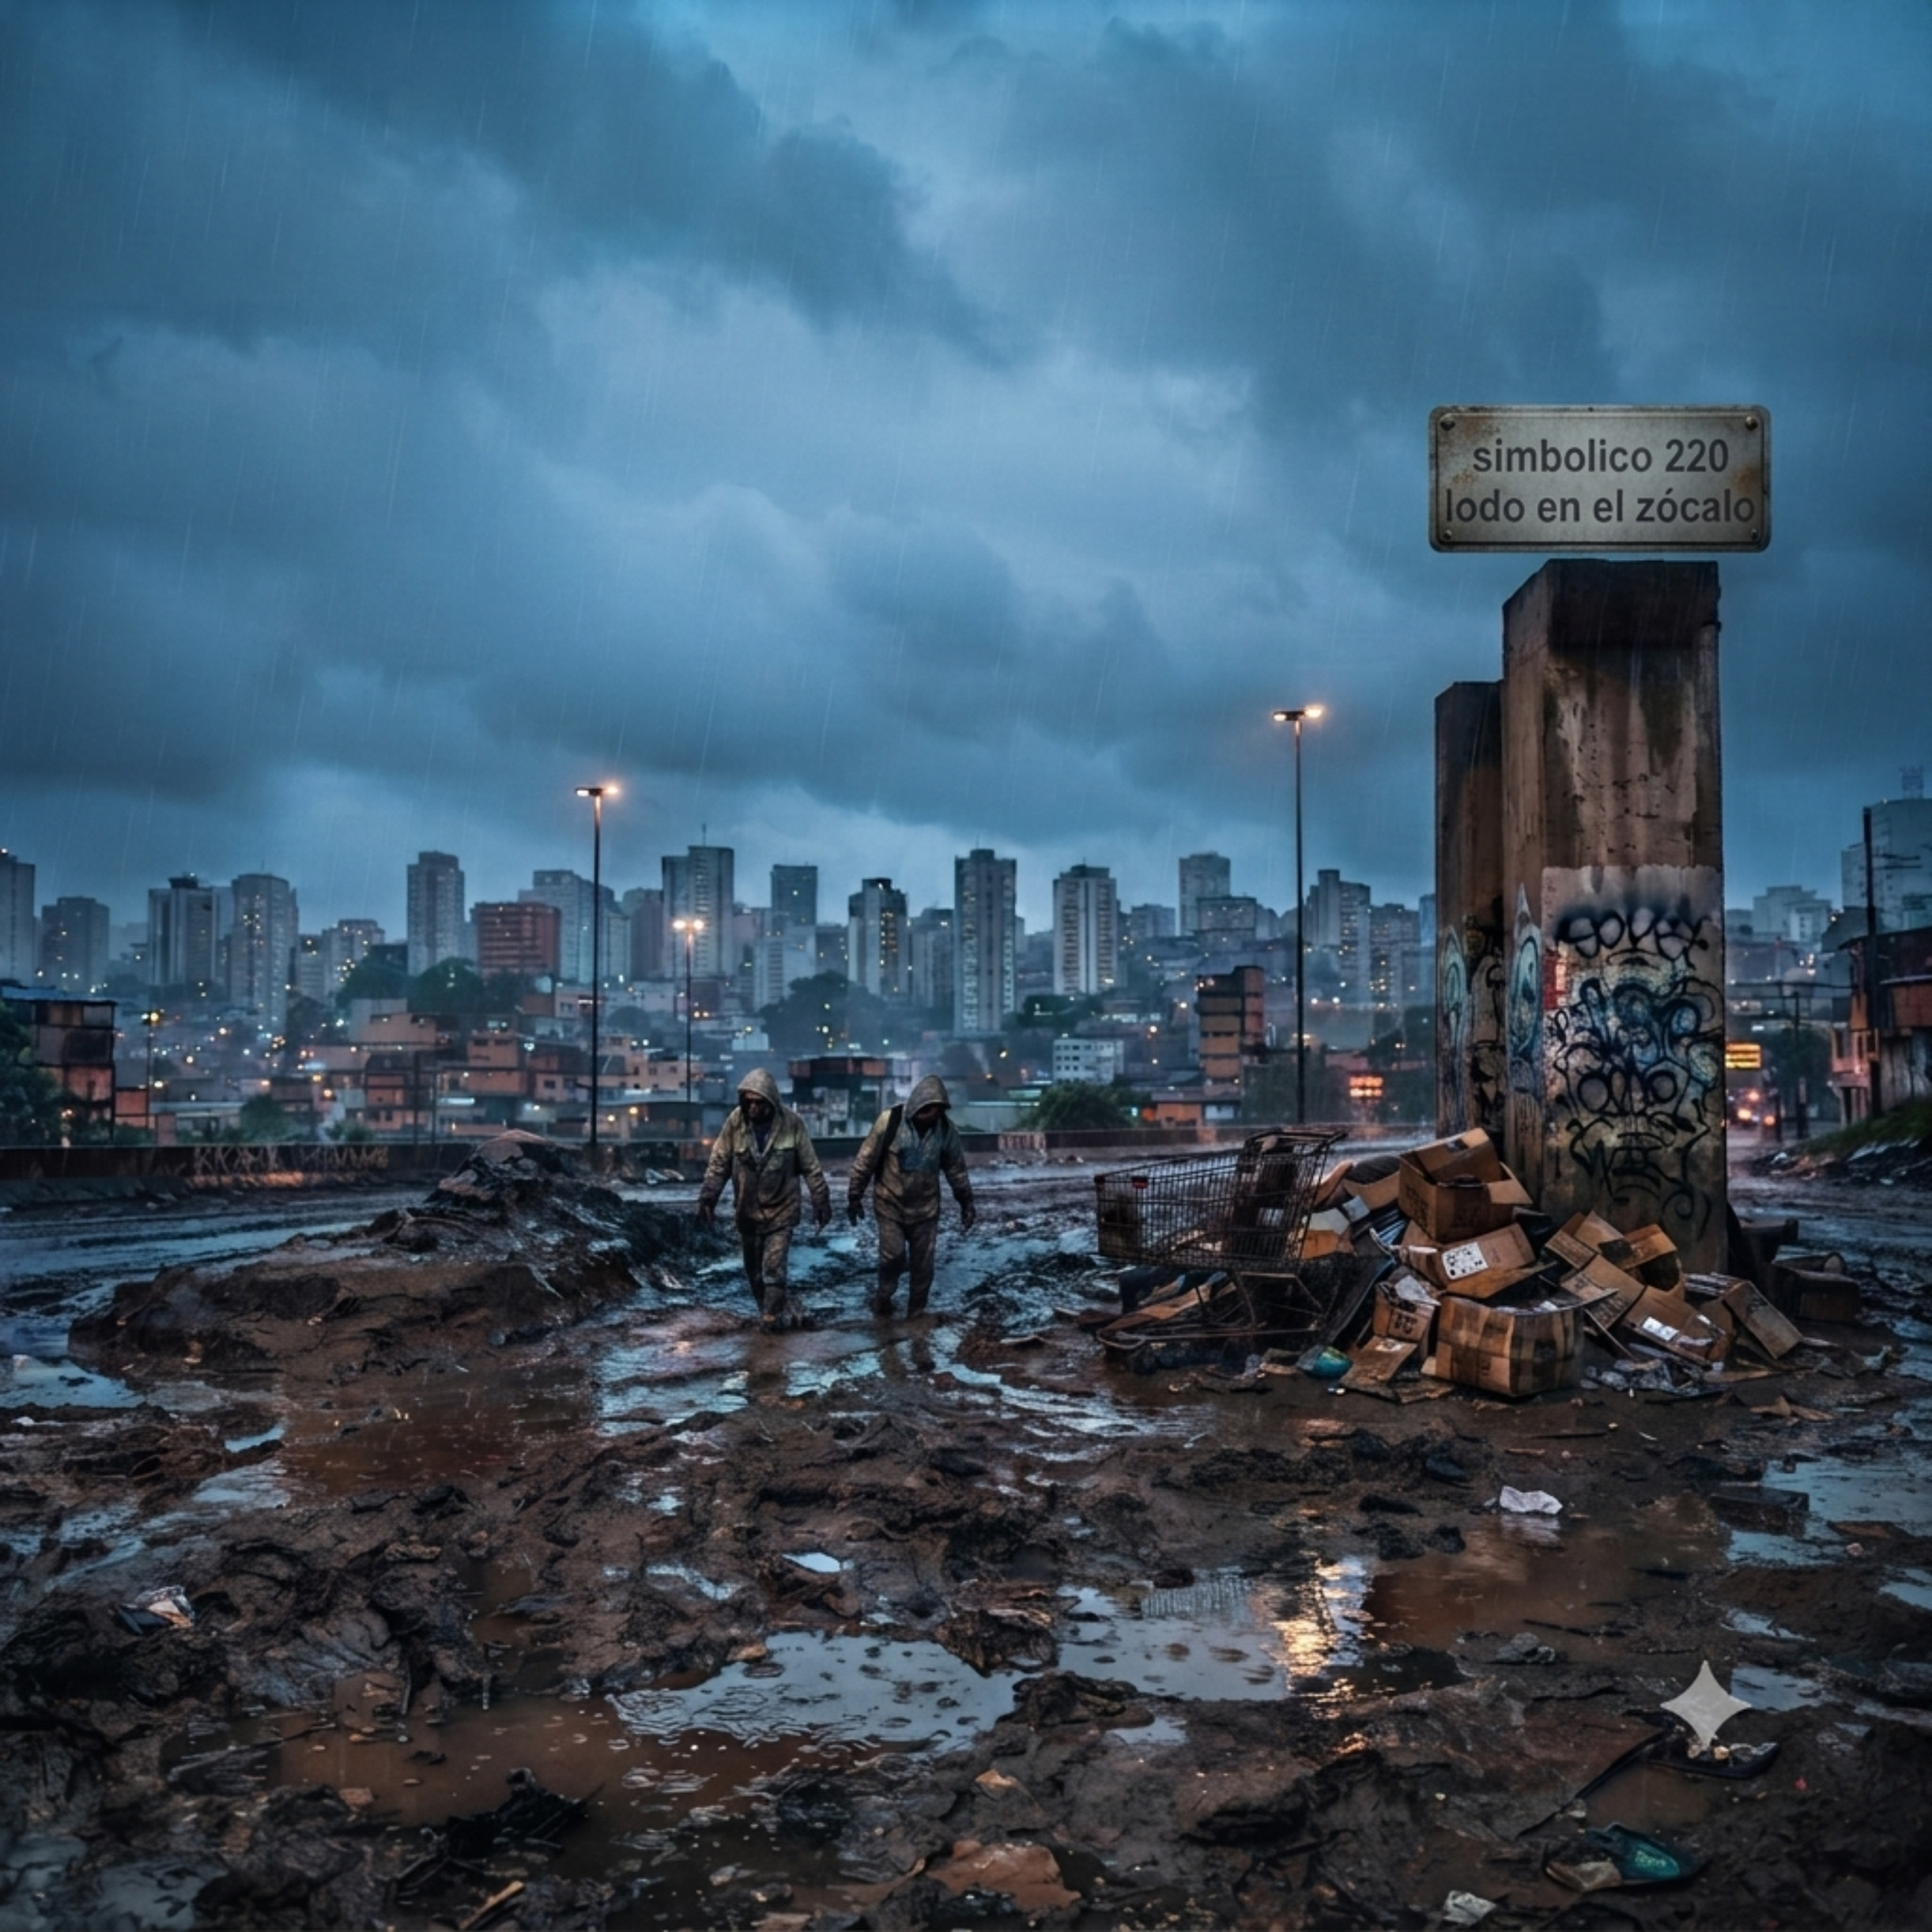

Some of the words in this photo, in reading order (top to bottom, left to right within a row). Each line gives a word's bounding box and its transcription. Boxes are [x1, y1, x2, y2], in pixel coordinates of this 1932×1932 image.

[1472, 439, 1652, 472] simbolico
[1665, 439, 1728, 472] 220
[1446, 488, 1524, 523] lodo
[1537, 498, 1580, 522] en
[1593, 489, 1624, 522] el
[1636, 488, 1755, 523] zócalo
